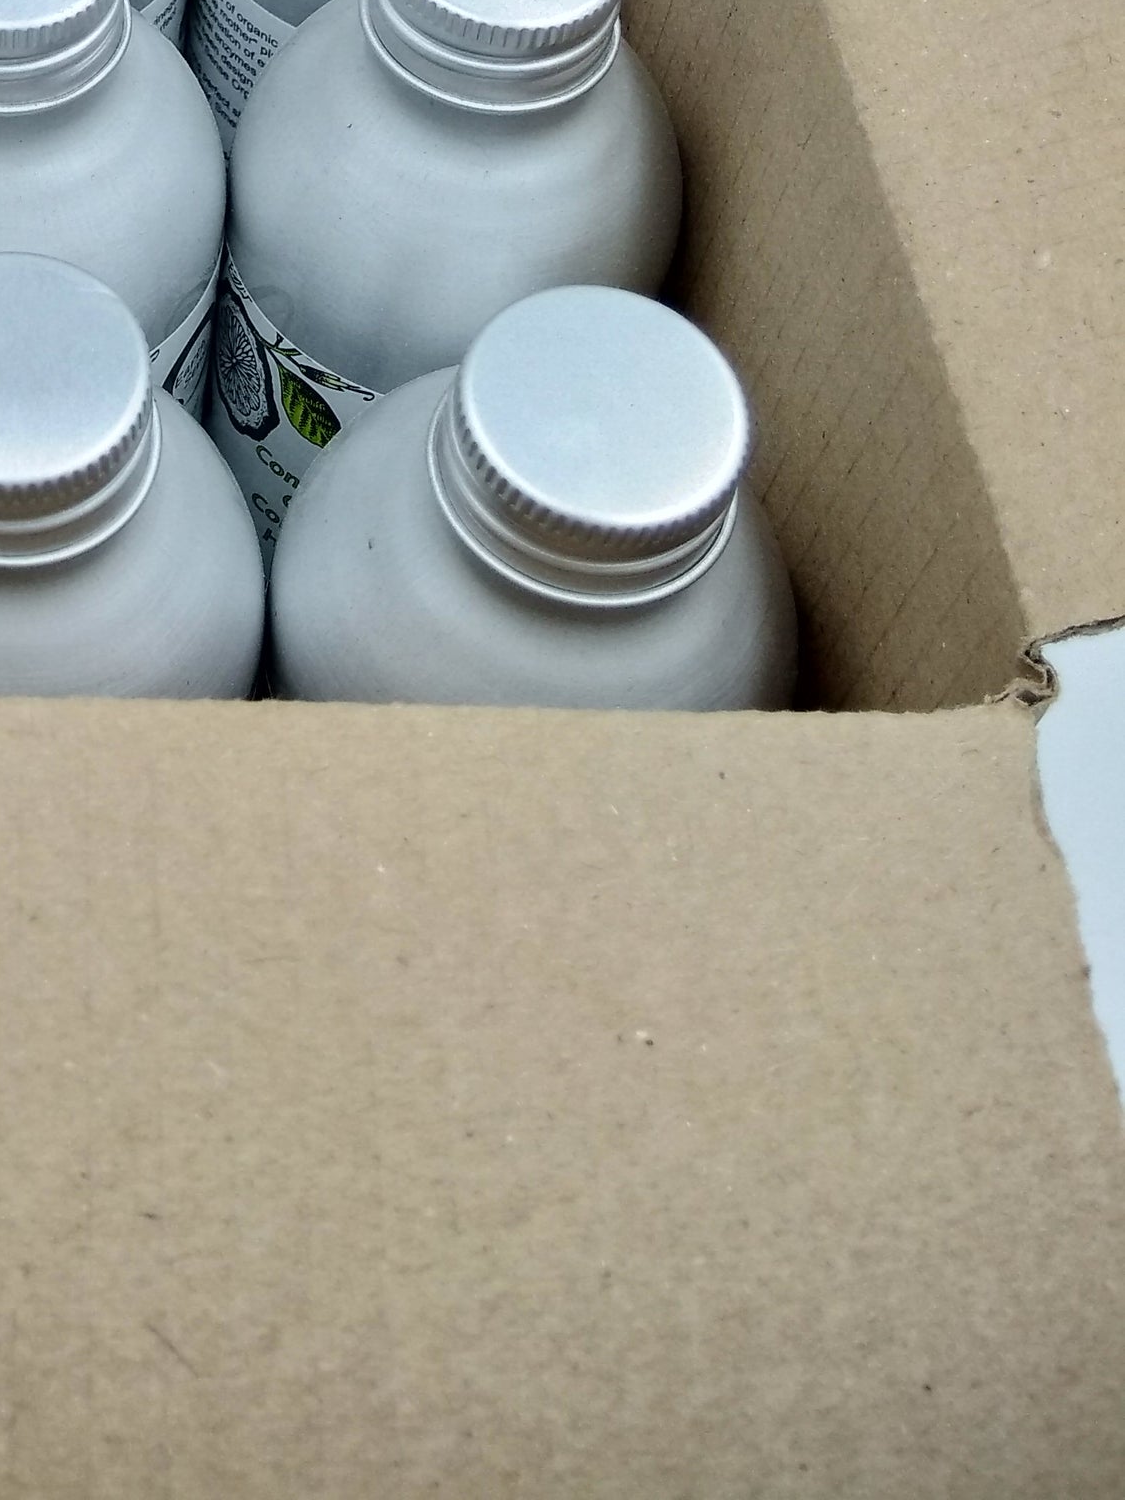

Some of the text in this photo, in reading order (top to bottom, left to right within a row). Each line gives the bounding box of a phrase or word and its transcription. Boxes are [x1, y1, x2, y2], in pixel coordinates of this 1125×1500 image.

[225, 1, 235, 13] of
[236, 13, 278, 48] organic
[214, 31, 257, 76] enzymes
[243, 48, 255, 59] of
[256, 445, 300, 489] Con
